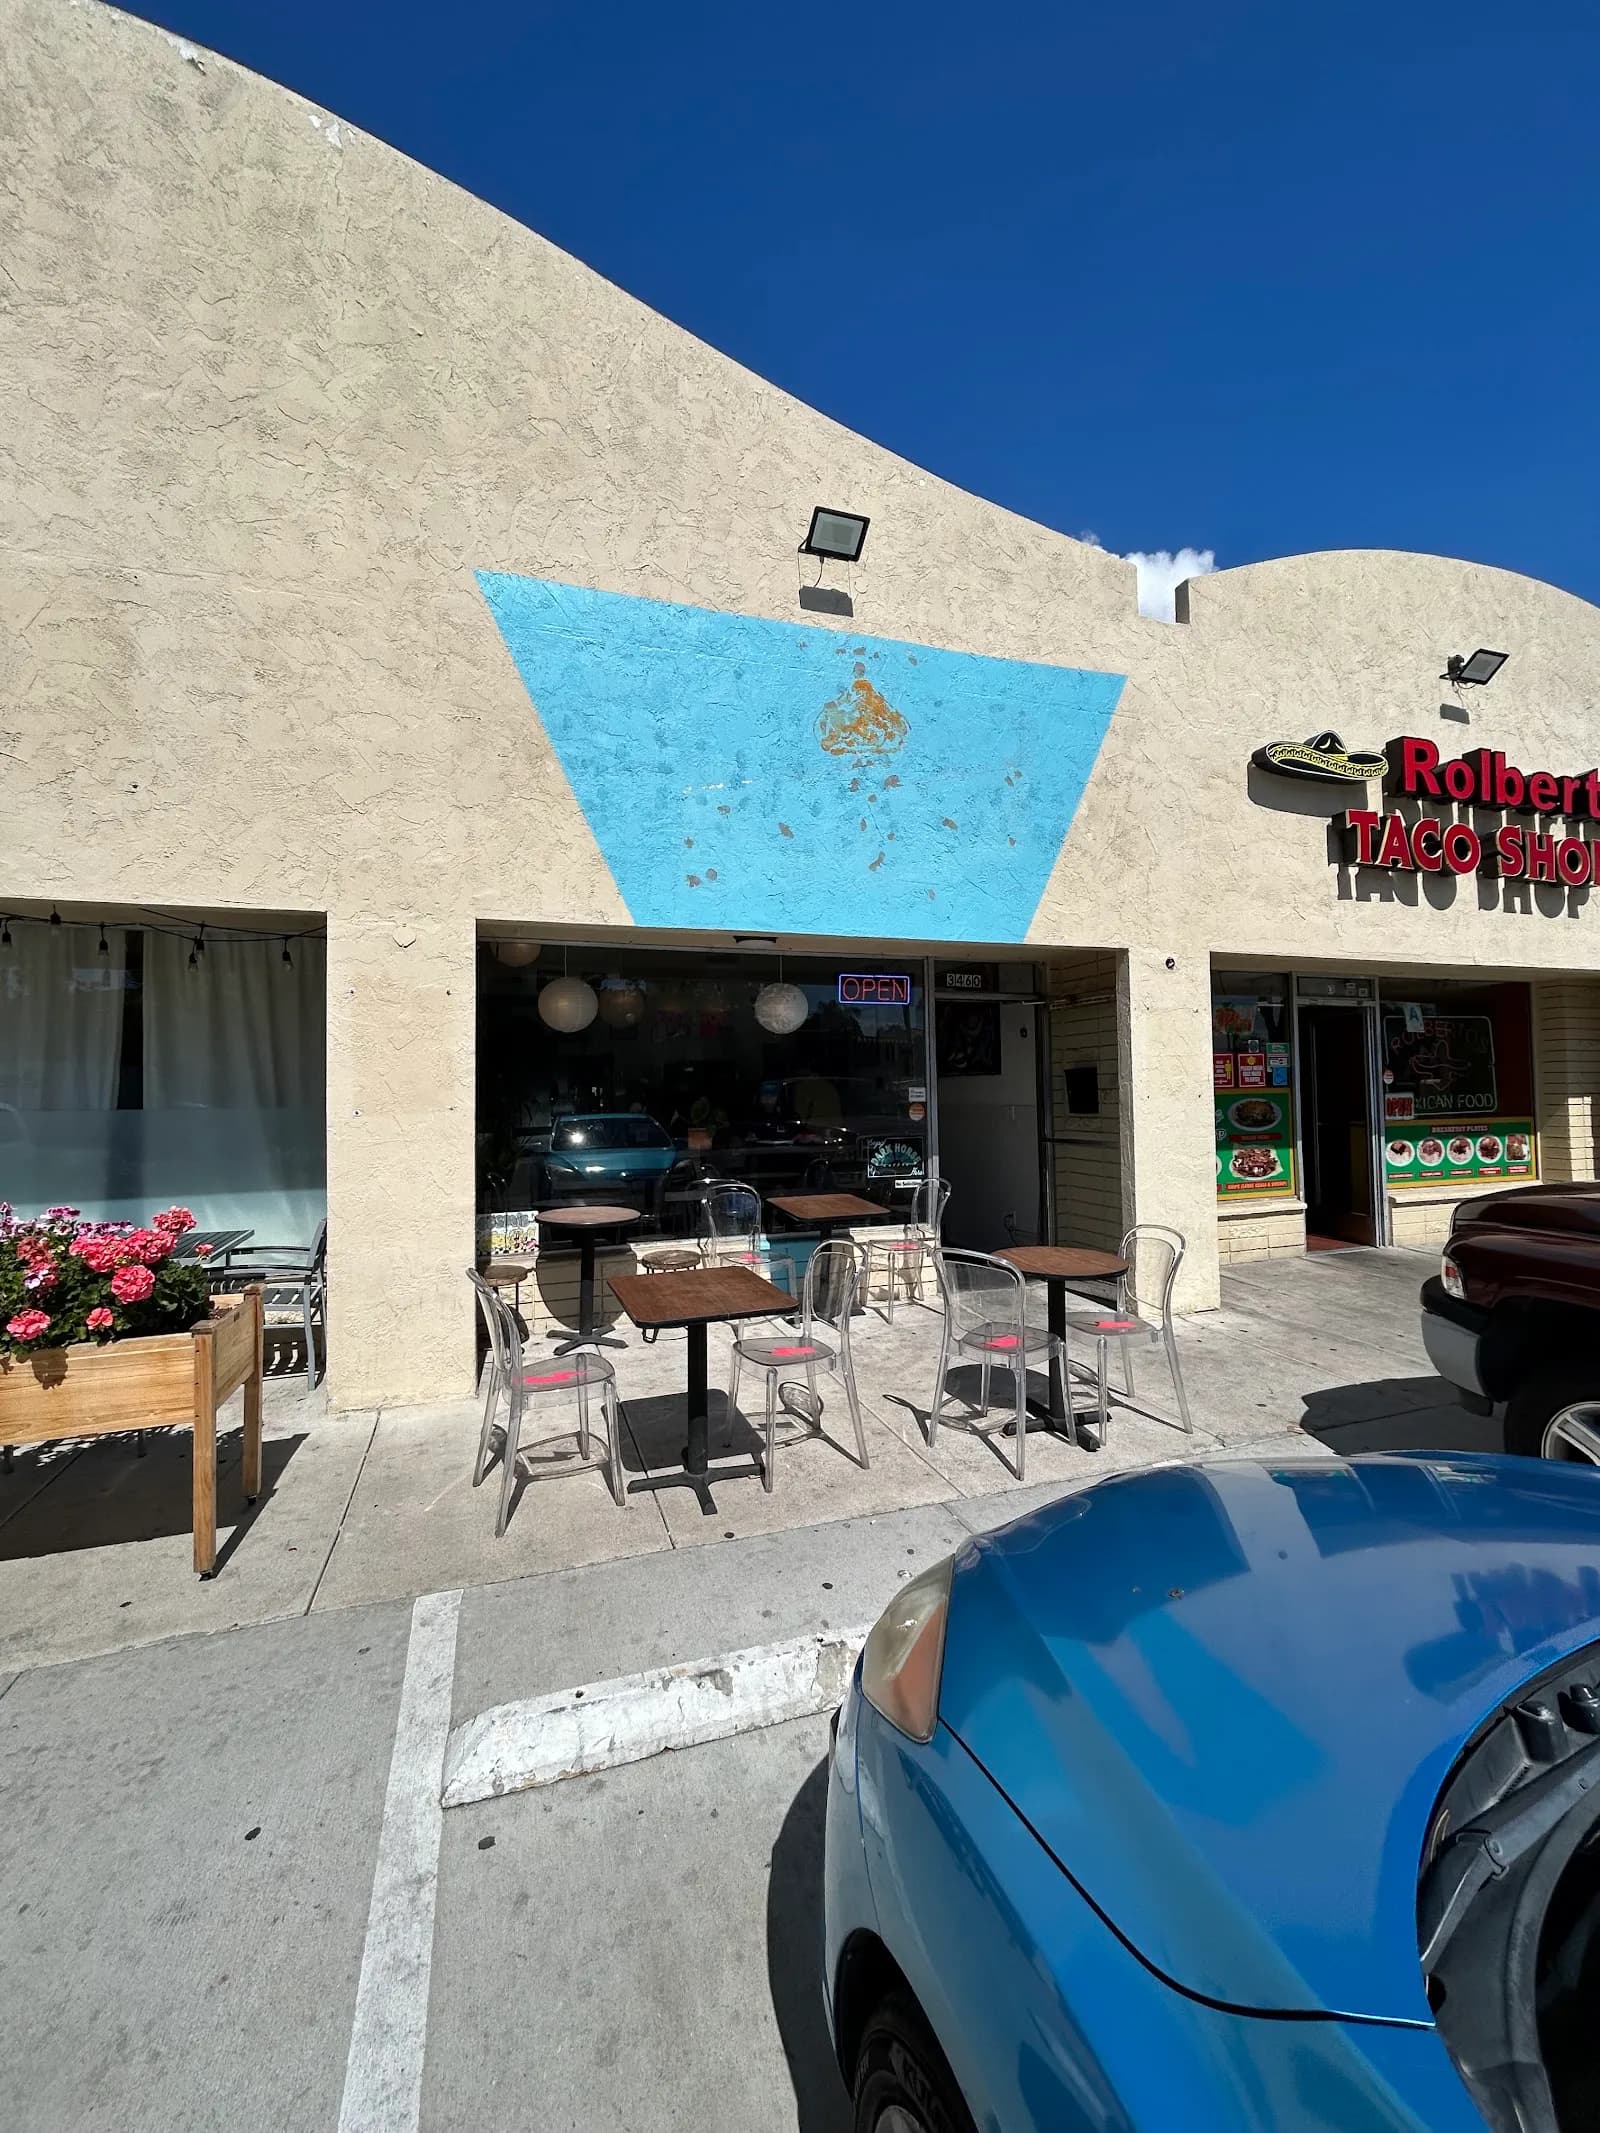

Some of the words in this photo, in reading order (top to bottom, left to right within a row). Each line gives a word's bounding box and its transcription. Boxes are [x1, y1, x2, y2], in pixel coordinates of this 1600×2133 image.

[1346, 808, 1481, 875] TACO
[842, 978, 907, 1001] OPEN
[946, 974, 982, 988] 3460
[1409, 1007, 1419, 1020] A
[1457, 1093, 1494, 1108] FOOD
[870, 1143, 893, 1166] DARK
[894, 1144, 922, 1164] HORSE
